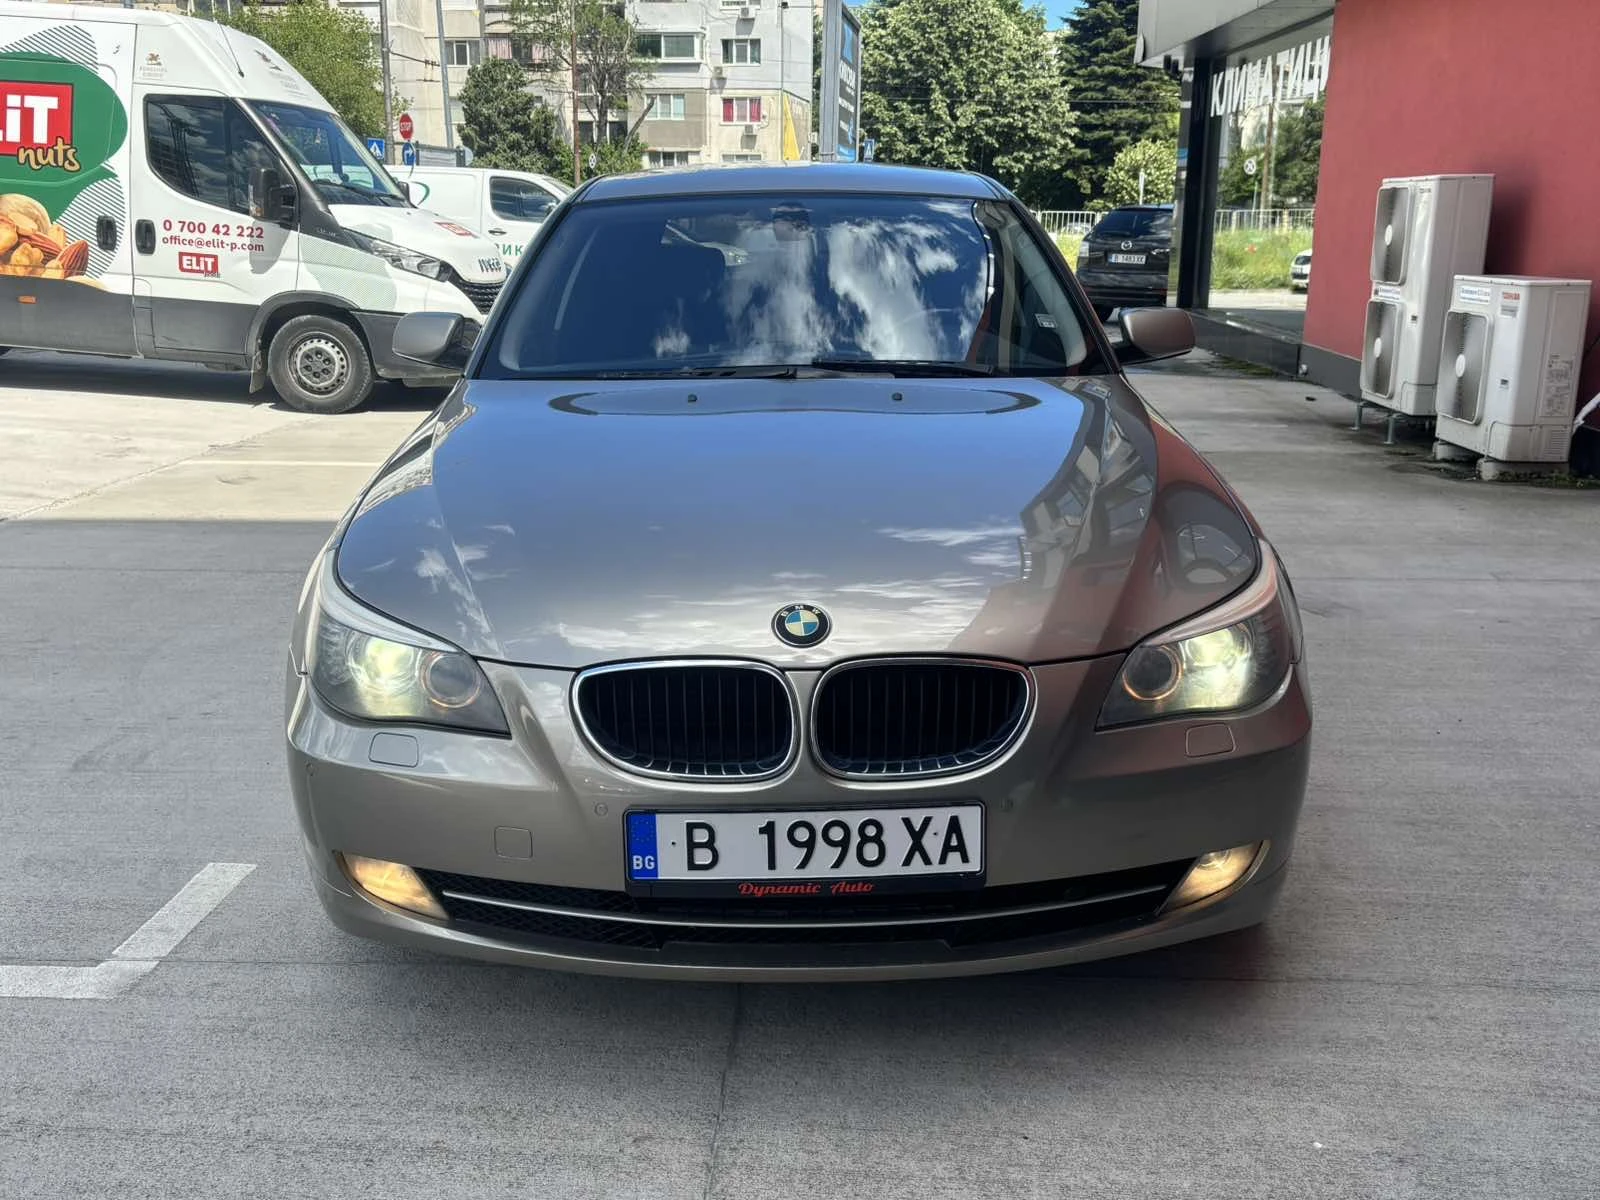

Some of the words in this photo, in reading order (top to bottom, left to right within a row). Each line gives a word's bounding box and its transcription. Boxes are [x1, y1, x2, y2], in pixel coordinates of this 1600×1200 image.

[18, 136, 81, 173] nuts
[163, 219, 173, 232] 0
[178, 220, 207, 234] 700
[212, 223, 231, 237] 42
[236, 224, 264, 239] 222
[162, 235, 265, 252] office@elit-p.com
[685, 820, 719, 871] B
[758, 818, 886, 871] 1998
[632, 855, 655, 870] BG
[738, 882, 821, 896] Dynamic
[830, 881, 874, 895] Auto
